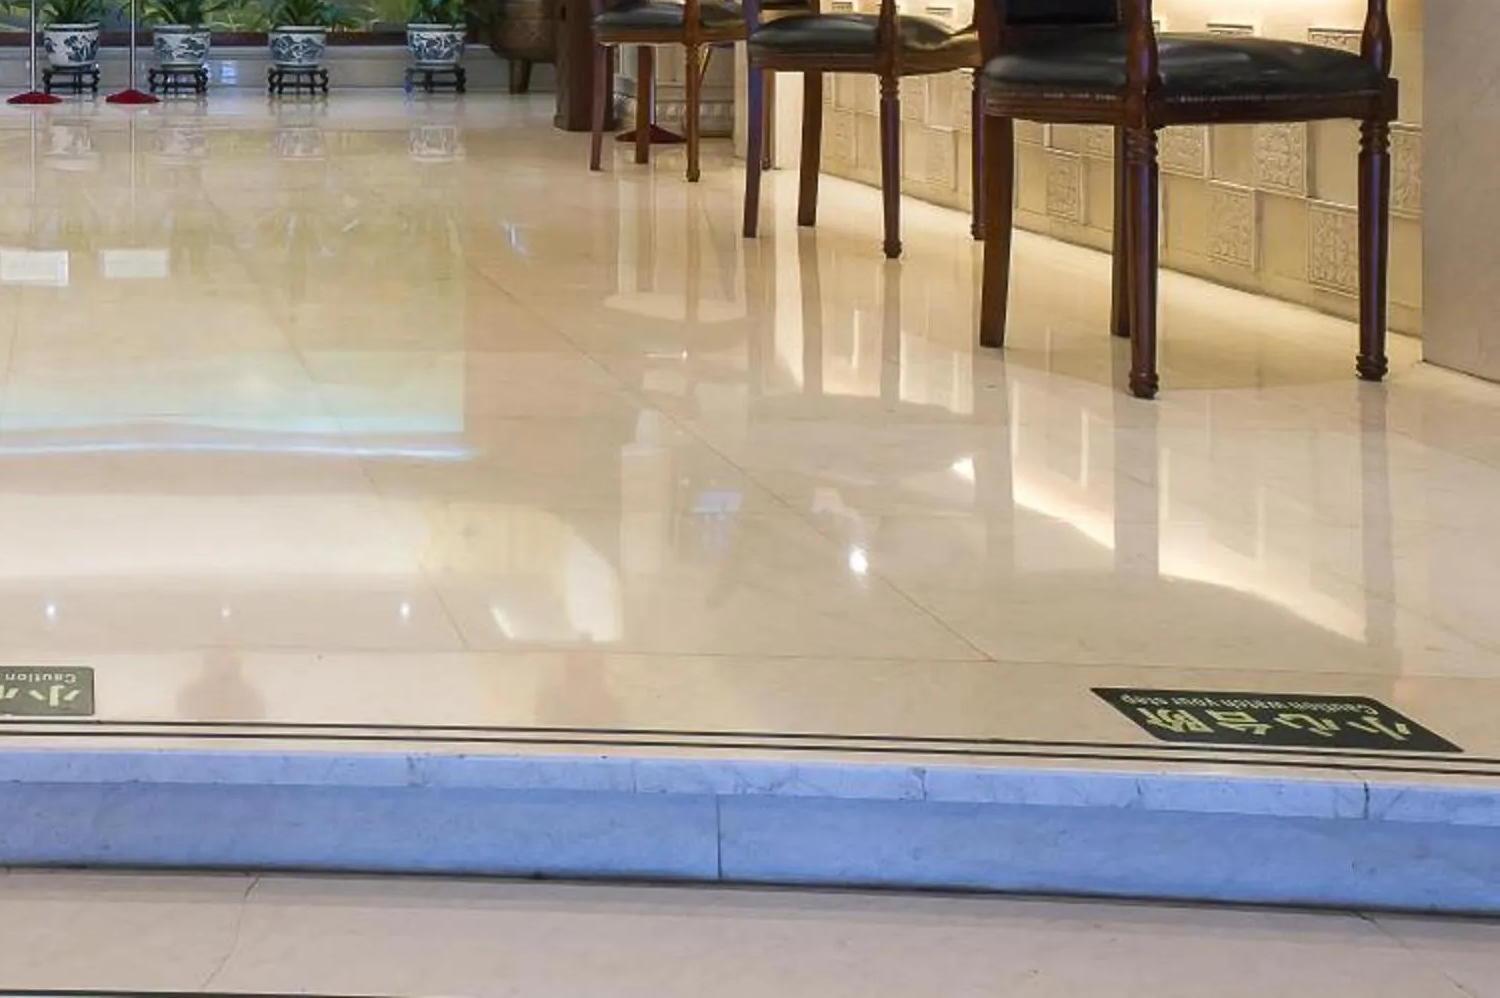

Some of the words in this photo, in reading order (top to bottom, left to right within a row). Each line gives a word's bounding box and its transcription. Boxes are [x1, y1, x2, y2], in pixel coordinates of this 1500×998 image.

[5, 672, 77, 684] Caution
[1136, 706, 1412, 742] 小心台阶
